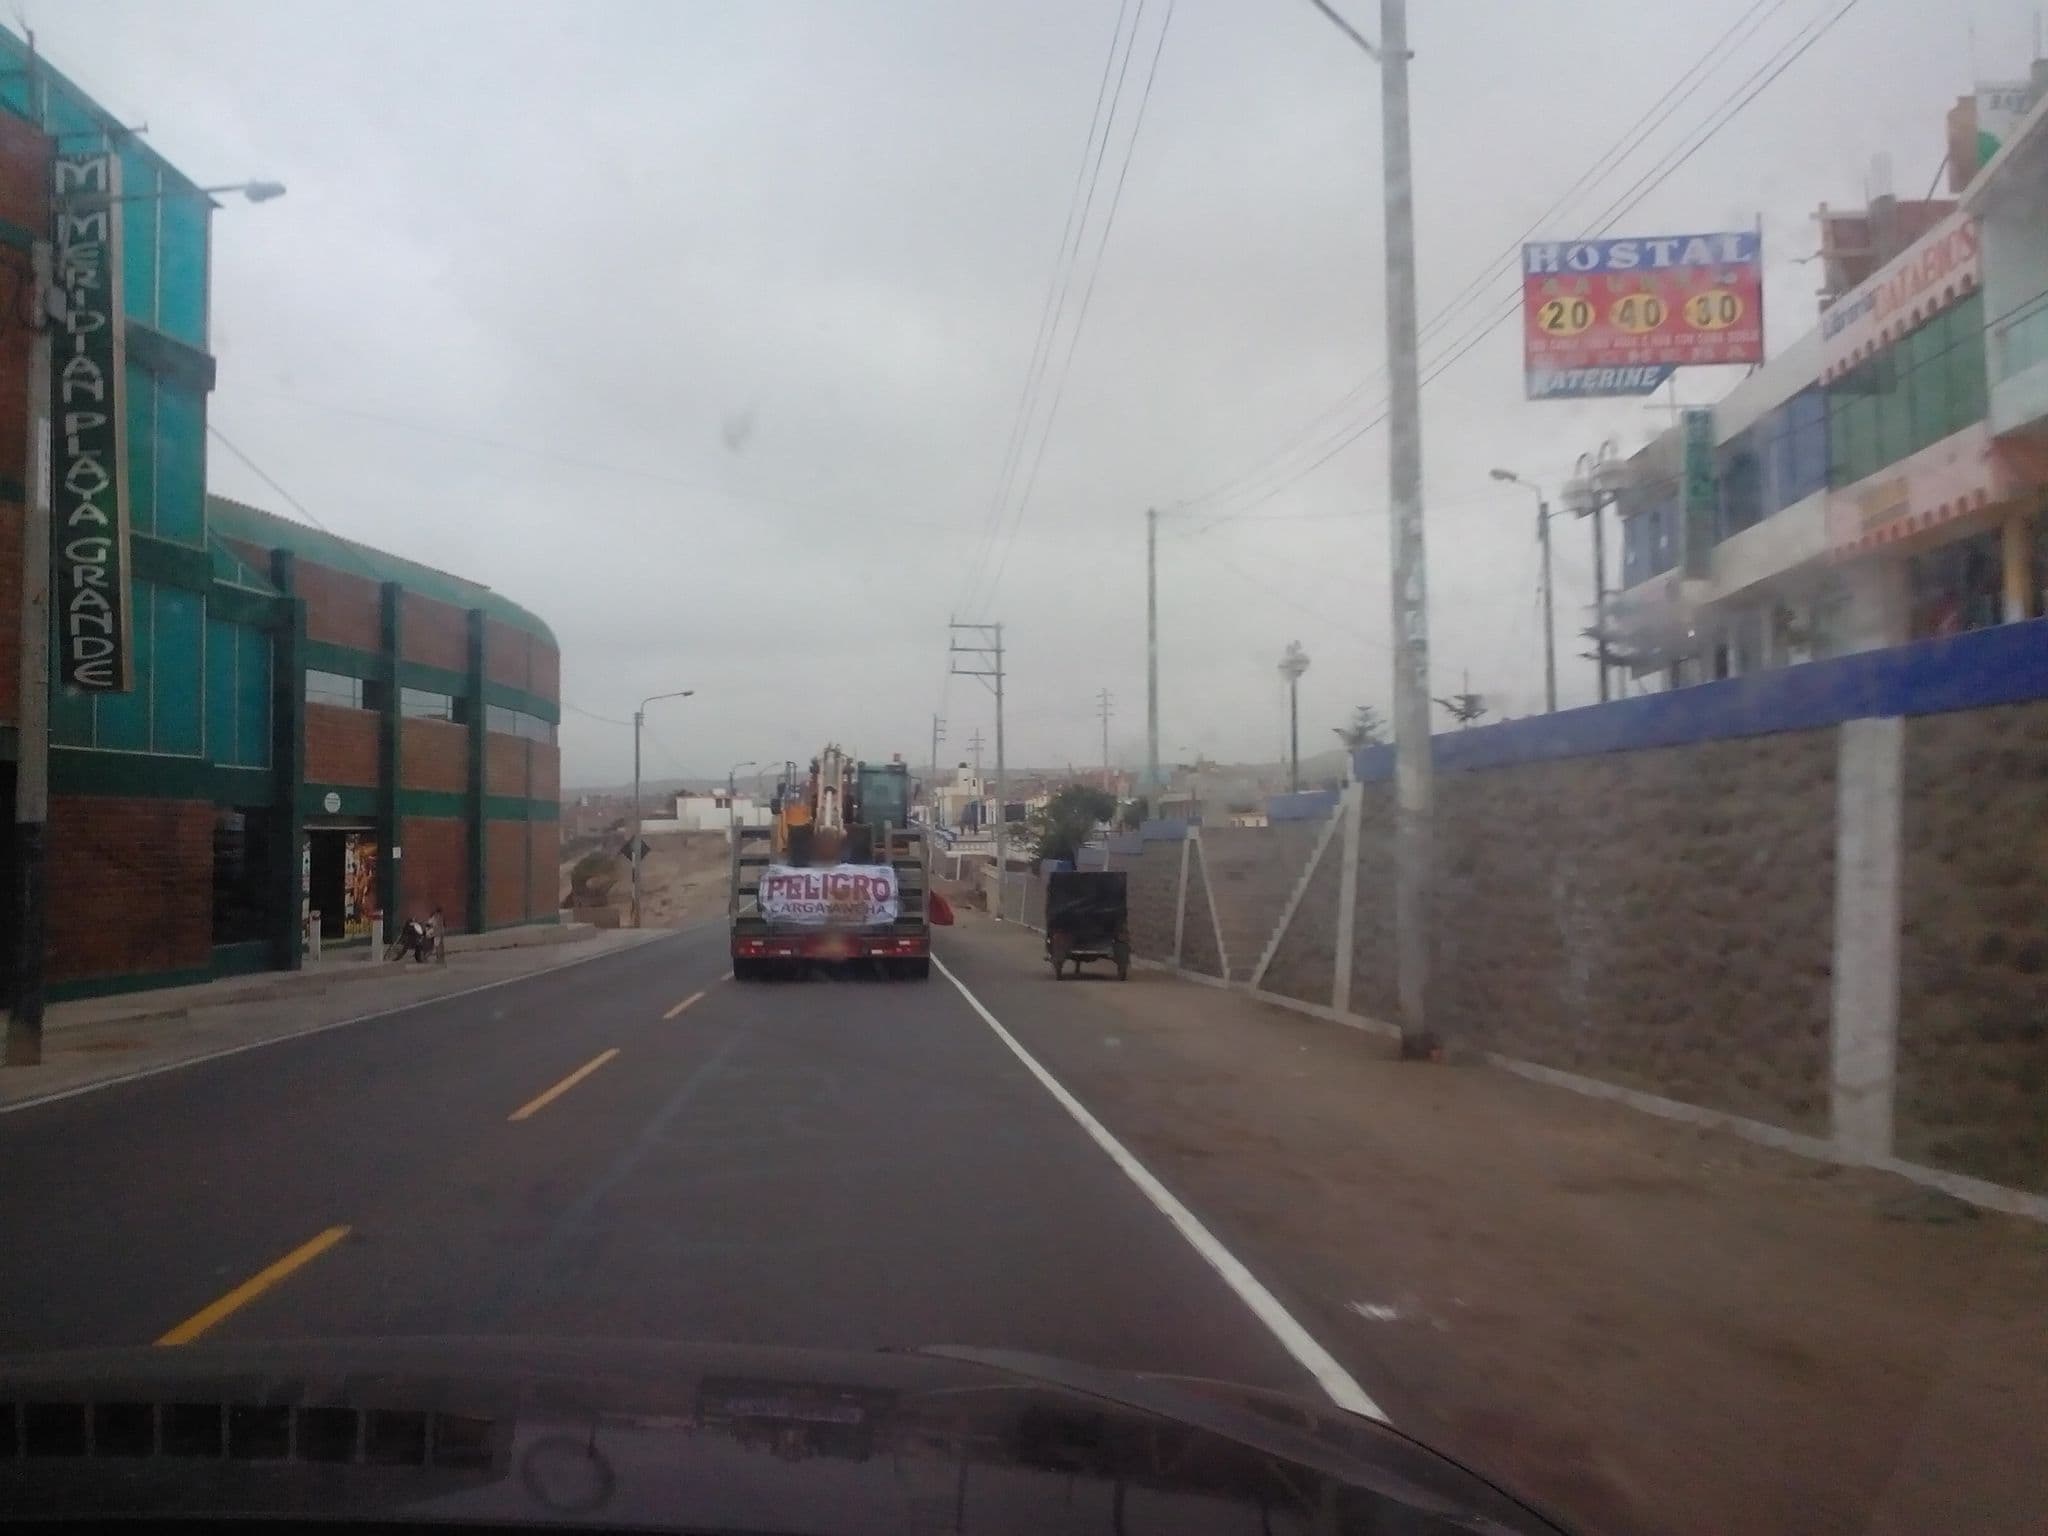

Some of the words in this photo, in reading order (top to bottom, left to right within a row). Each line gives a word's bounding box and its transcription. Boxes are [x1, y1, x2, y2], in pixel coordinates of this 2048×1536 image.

[1527, 234, 1752, 273] HOSTAL
[1547, 300, 1589, 330] 20
[1619, 298, 1661, 328] 40
[65, 411, 110, 526] PLAYA
[66, 536, 114, 687] GRANDE
[767, 872, 891, 902] PELIGRO
[770, 902, 824, 914] CARGA
